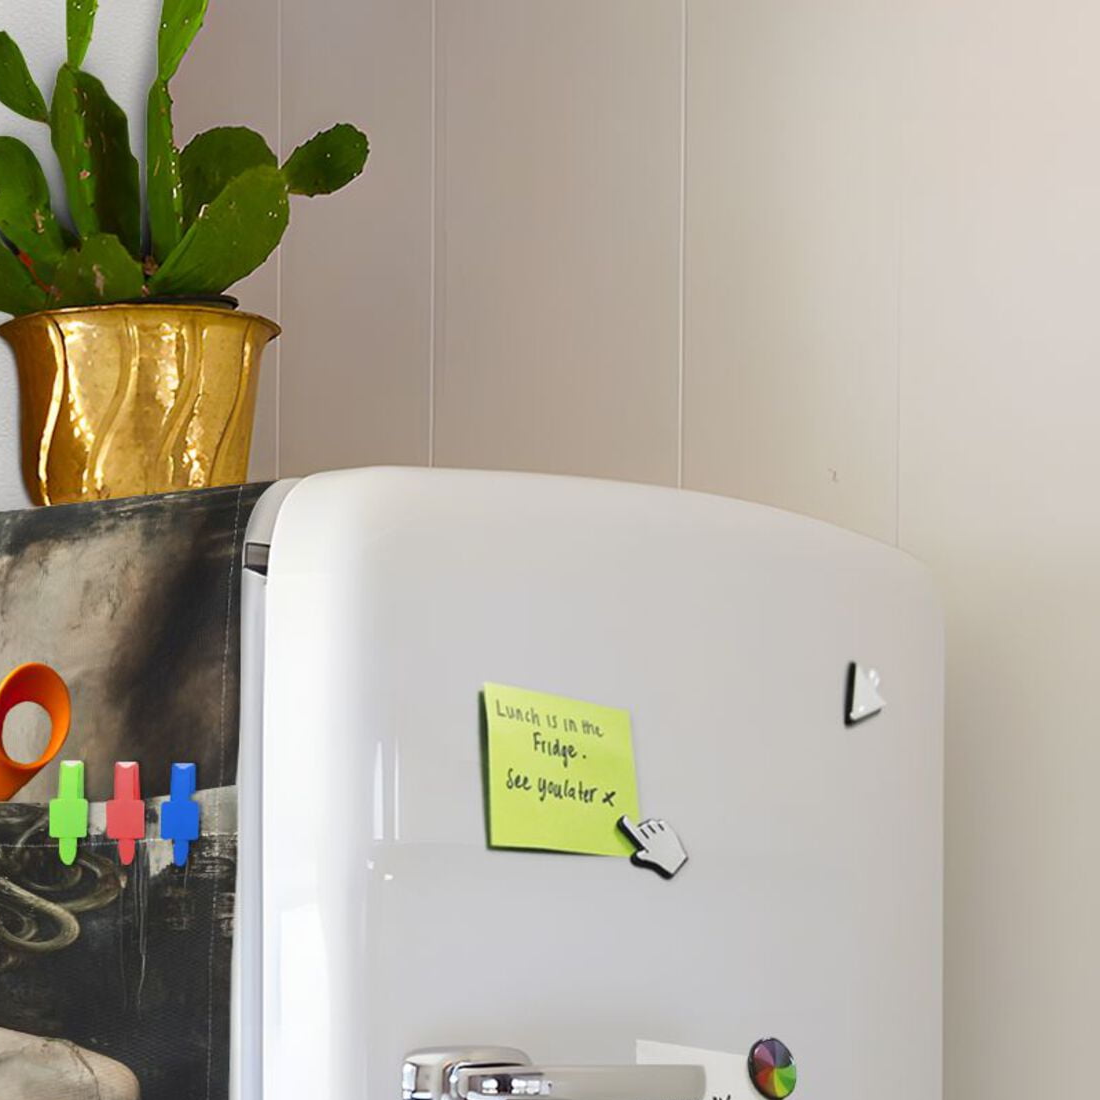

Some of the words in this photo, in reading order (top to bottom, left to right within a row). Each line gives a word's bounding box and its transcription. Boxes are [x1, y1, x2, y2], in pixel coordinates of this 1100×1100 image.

[495, 698, 541, 728] Lunch
[546, 714, 558, 729] is
[563, 717, 579, 733] in
[581, 719, 604, 738] the
[505, 767, 533, 791] See
